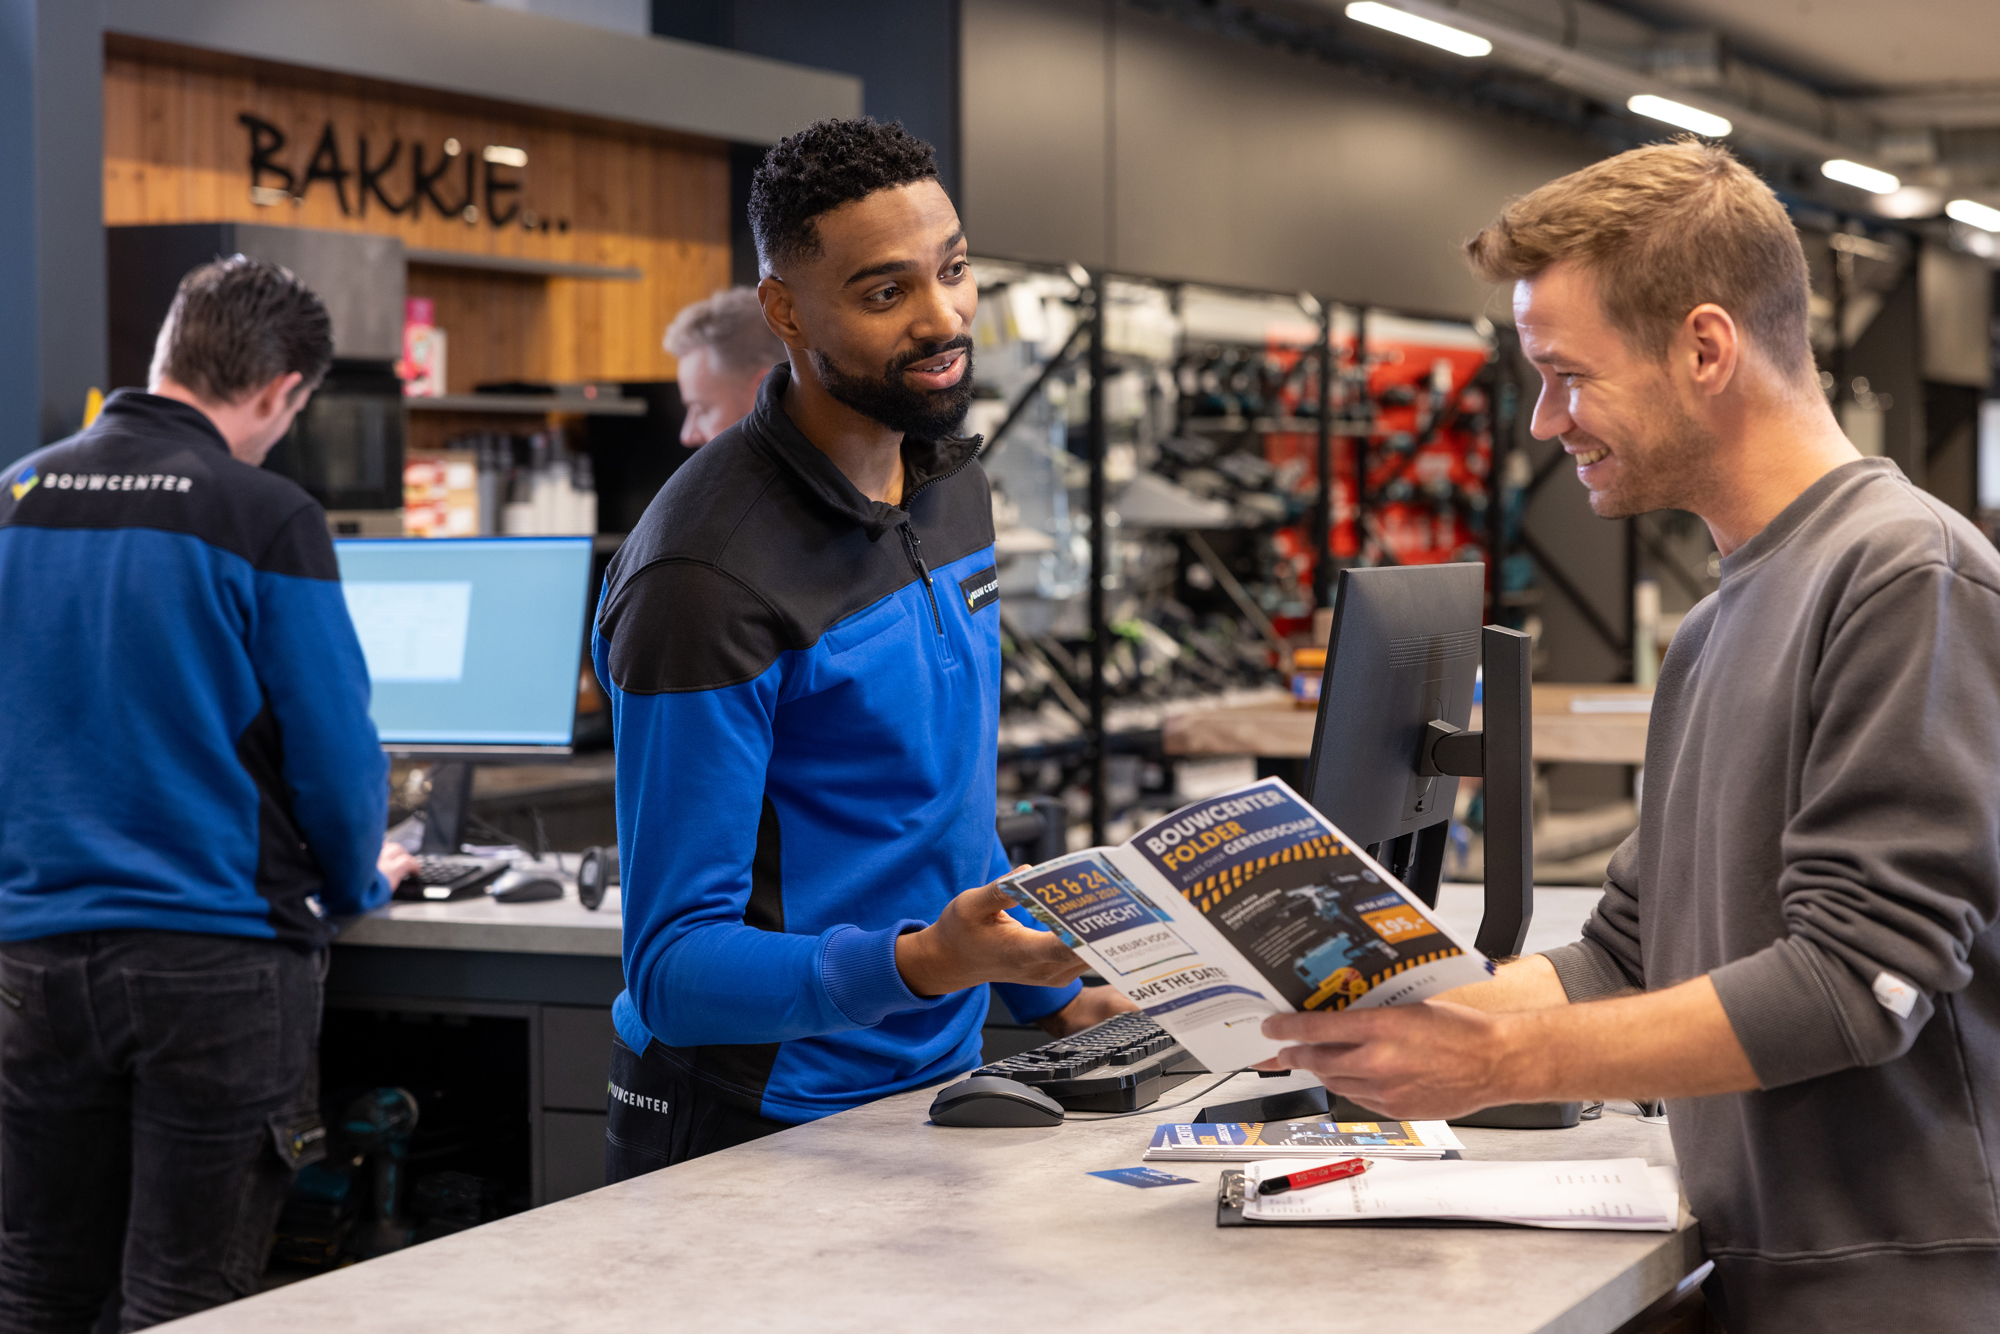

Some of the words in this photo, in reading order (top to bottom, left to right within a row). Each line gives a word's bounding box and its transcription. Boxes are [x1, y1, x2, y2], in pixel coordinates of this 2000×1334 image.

[43, 472, 193, 493] BOUWCENTER
[1145, 790, 1288, 856] BOUWCENTER
[1162, 820, 1247, 871] FOLDER
[1182, 863, 1207, 883] ALLES
[1203, 851, 1227, 870] OVER
[1223, 816, 1318, 856] GEREEDSCHAP
[1036, 883, 1067, 904] 23
[1079, 869, 1110, 890] 24
[1054, 892, 1099, 915] JANUARI
[1072, 902, 1144, 934] UTRECHT
[1118, 935, 1149, 955] BEURS
[1146, 931, 1171, 945] VOOR
[1128, 982, 1166, 1002] SAVE
[1162, 972, 1195, 990] THE
